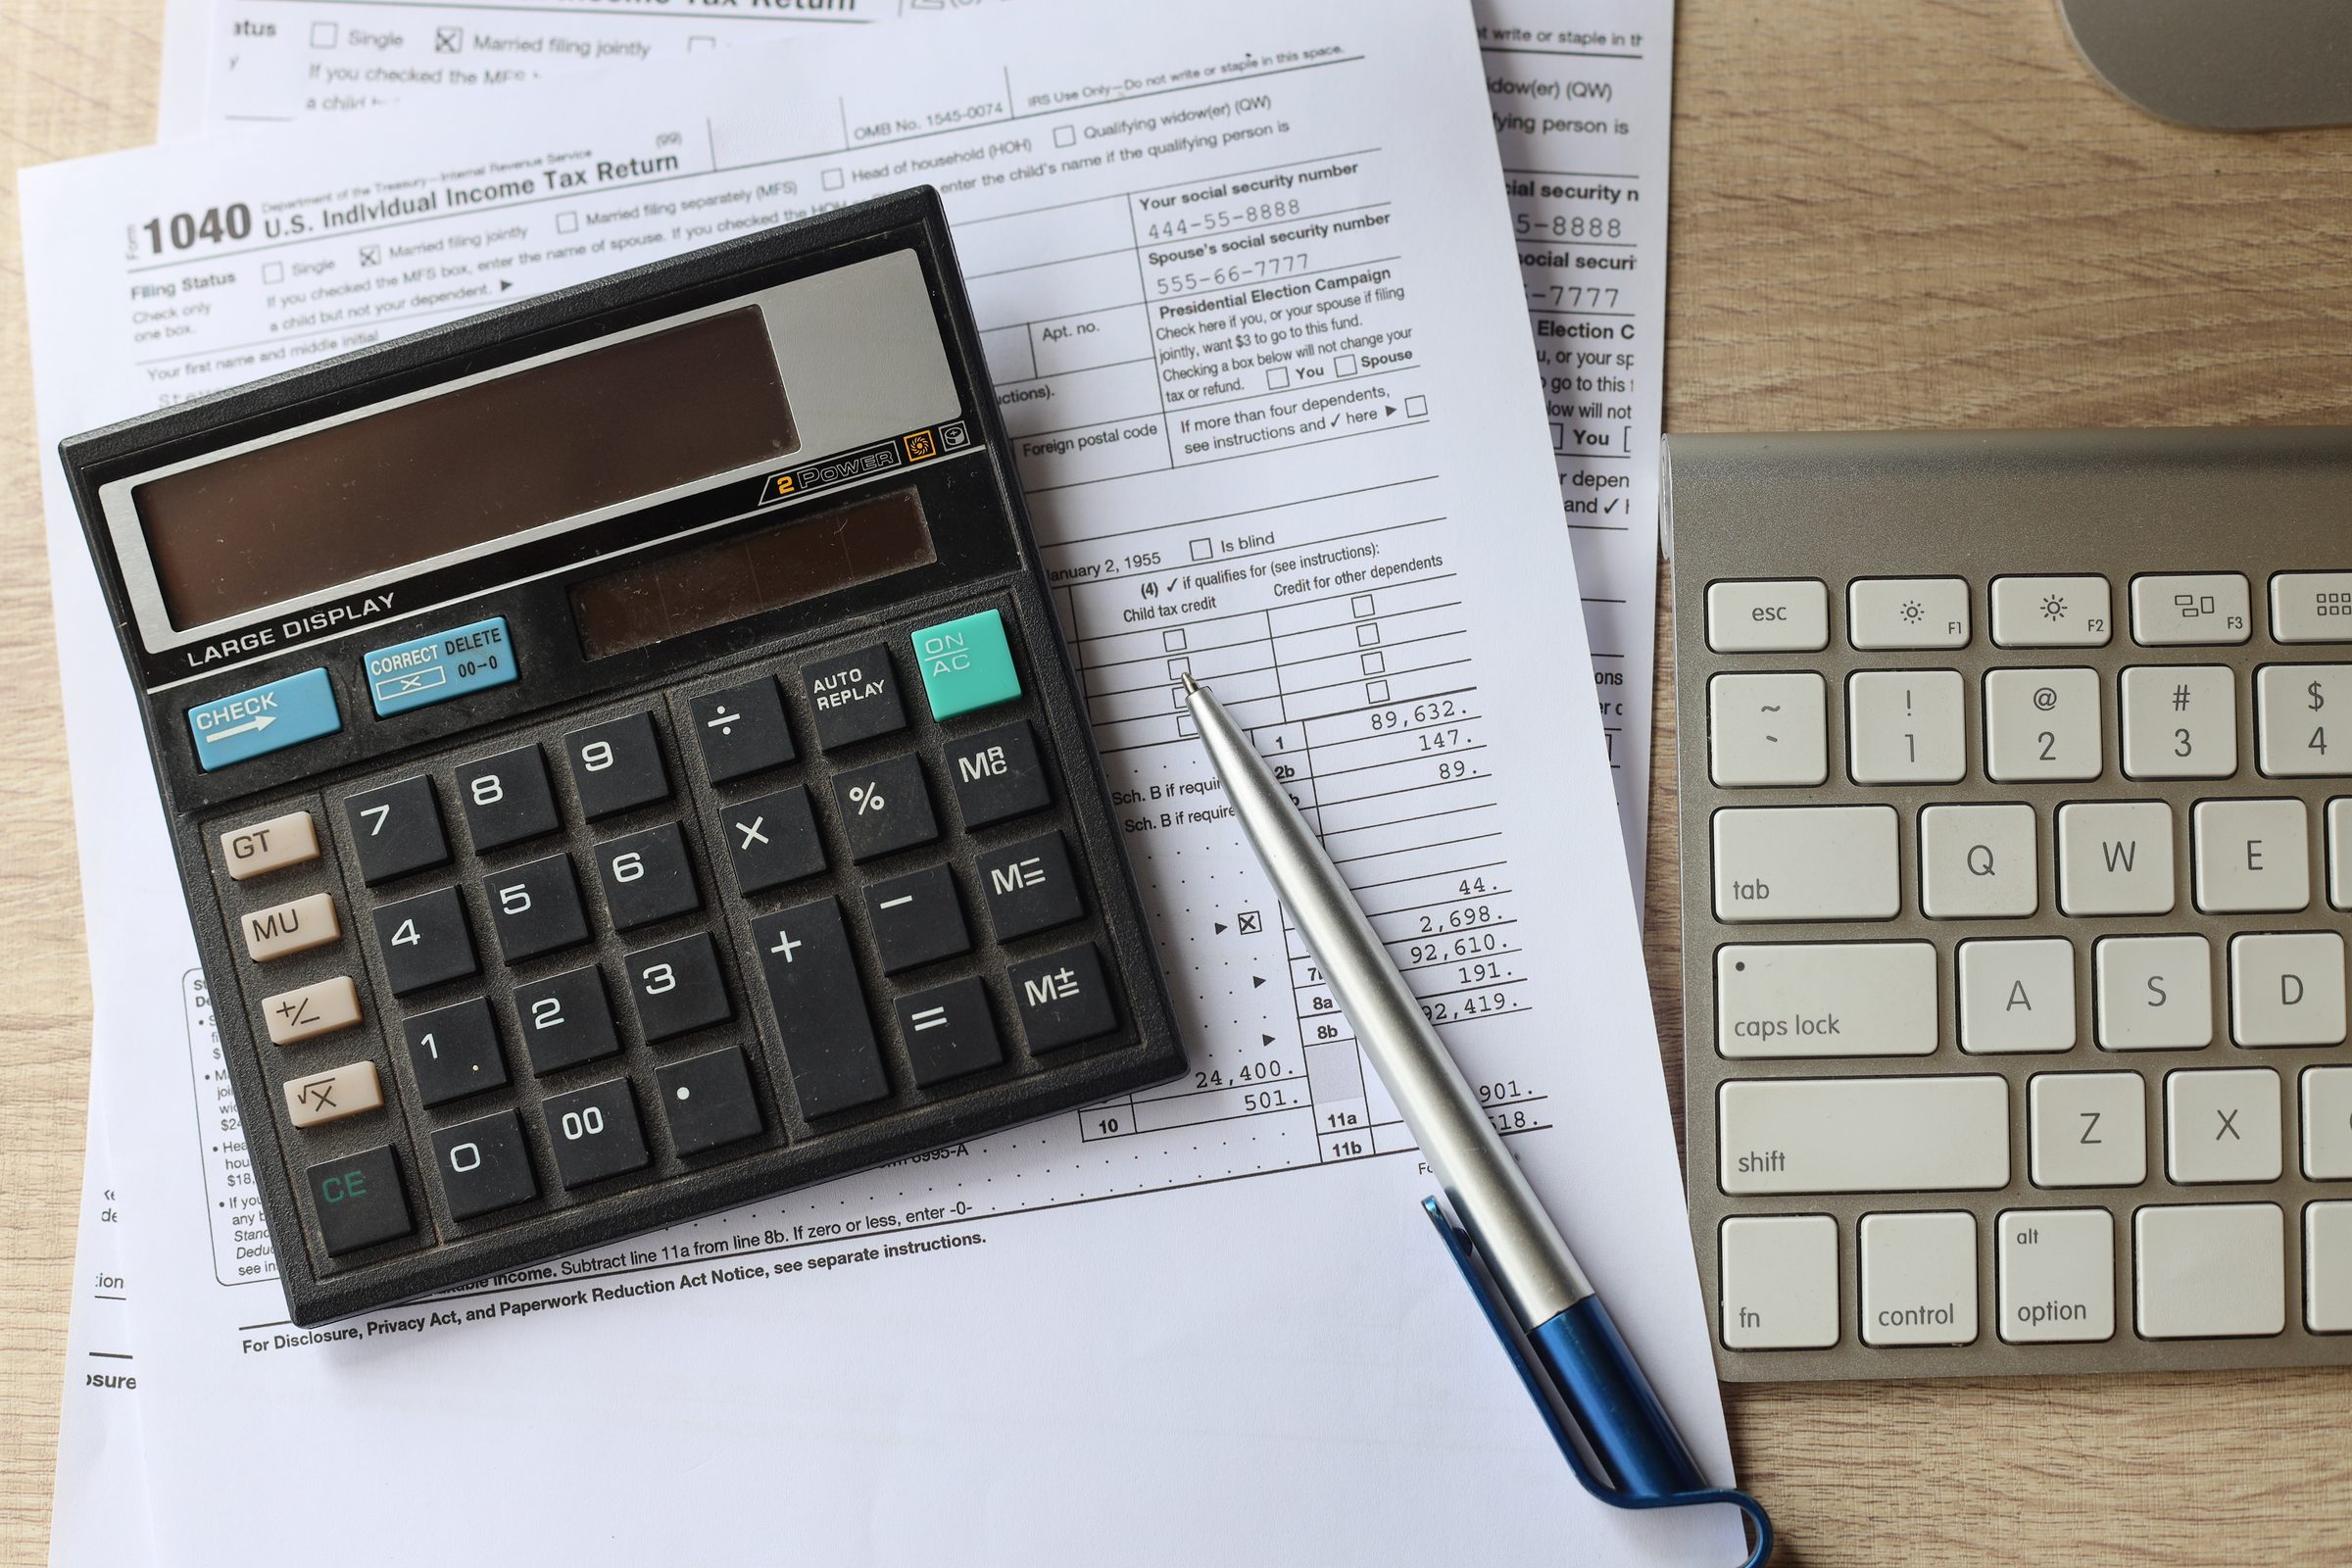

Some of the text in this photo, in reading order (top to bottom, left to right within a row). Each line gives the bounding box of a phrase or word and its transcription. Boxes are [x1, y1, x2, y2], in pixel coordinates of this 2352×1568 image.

[853, 101, 1004, 141] OMB No. 1545-0074
[1083, 94, 1272, 140] Qualifying widow(er) (QW)
[264, 155, 680, 239] U.S. Individual Income Tax Return
[1139, 164, 1359, 212] Your social security number
[1540, 184, 1622, 205] security
[143, 202, 252, 255] 1040
[1149, 198, 1300, 240] 444-55-8888
[1148, 214, 1391, 268] Spouse's social security number
[130, 272, 236, 301] Filing Status
[1156, 253, 1308, 296] 555-66-7777
[1158, 269, 1392, 319] Presidential Election Campaign
[1042, 322, 1101, 343] Apt. no.
[1537, 319, 1614, 340] Election
[1180, 386, 1391, 434] If more than four dependents,
[1022, 423, 1158, 459] Foreign postal code
[1572, 428, 1610, 446] You
[776, 450, 894, 495] 2 POWER
[1220, 530, 1276, 554] Is blind
[1140, 541, 1380, 600] (4) if qualifies for (see instructions):
[1273, 555, 1444, 597] Credit for other dependents
[1122, 596, 1217, 623] Child tax credit
[1751, 607, 1788, 622] esc
[2227, 615, 2243, 630] F3
[186, 592, 394, 667] LARGE DISPLAY
[1948, 620, 1962, 635] F1
[2087, 618, 2104, 632] F2
[444, 627, 503, 656] DELETE
[925, 632, 964, 655] ON
[370, 645, 438, 676] CORRECT
[933, 654, 971, 676] AC
[813, 667, 862, 694] AUTO
[816, 679, 885, 711] REPLAY
[196, 692, 278, 730] CHECK
[1906, 689, 1912, 717] !
[2033, 687, 2057, 711] @
[2172, 684, 2191, 711] #
[2307, 680, 2325, 712] $
[1368, 697, 1467, 731] 89,632.
[1275, 736, 1285, 750] 1
[1418, 728, 1472, 752] 147.
[1904, 733, 1915, 763] 1
[2037, 731, 2056, 761] 2
[2174, 728, 2192, 758] 3
[2308, 726, 2328, 756] 4
[581, 741, 614, 772] 9
[1439, 760, 1483, 780] 89.
[1274, 765, 1296, 780] 2b
[470, 774, 504, 807] 8
[849, 781, 885, 816] %
[360, 804, 390, 837] 7
[232, 829, 270, 859] GT
[2102, 840, 2136, 873] W
[2246, 840, 2264, 871] E
[612, 852, 645, 883] 6
[1967, 844, 1996, 876] Q
[499, 883, 532, 915] 5
[1458, 876, 1497, 896] 44.
[1733, 878, 1770, 901] tab
[252, 908, 299, 943] MU
[390, 918, 421, 947] 4
[1419, 905, 1503, 933] 2,698.
[1410, 933, 1514, 964] 92,610.
[642, 963, 676, 995] 3
[1458, 961, 1512, 984] 191.
[1312, 996, 1337, 1012] 8a
[2006, 980, 2032, 1012] A
[2147, 975, 2167, 1007] S
[2280, 974, 2304, 1005] D
[531, 998, 565, 1030] 2
[1734, 1012, 1840, 1042] caps lock
[420, 1033, 438, 1059] 1
[1316, 1024, 1339, 1040] 8b
[1195, 1059, 1300, 1090] 24,400.
[1244, 1089, 1298, 1111] 501.
[1099, 1118, 1119, 1135] 10
[1327, 1112, 1362, 1128] 11a
[2080, 1112, 2102, 1145] Z
[2216, 1108, 2240, 1141] X
[1332, 1141, 1367, 1158] 11b
[1738, 1150, 1786, 1173] shift
[321, 1162, 369, 1203] CE
[561, 1200, 973, 1276] Subtract line 11a from line 8b. If zero or less, enter -0-
[2016, 1228, 2038, 1245] alt
[242, 1233, 987, 1354] For Disclosure, Privacy Act, and Paperwork Reduction Act Notice, see separate instructions.
[1739, 1306, 1760, 1329] fn
[1878, 1302, 1954, 1327] control
[2017, 1300, 2086, 1327] option
